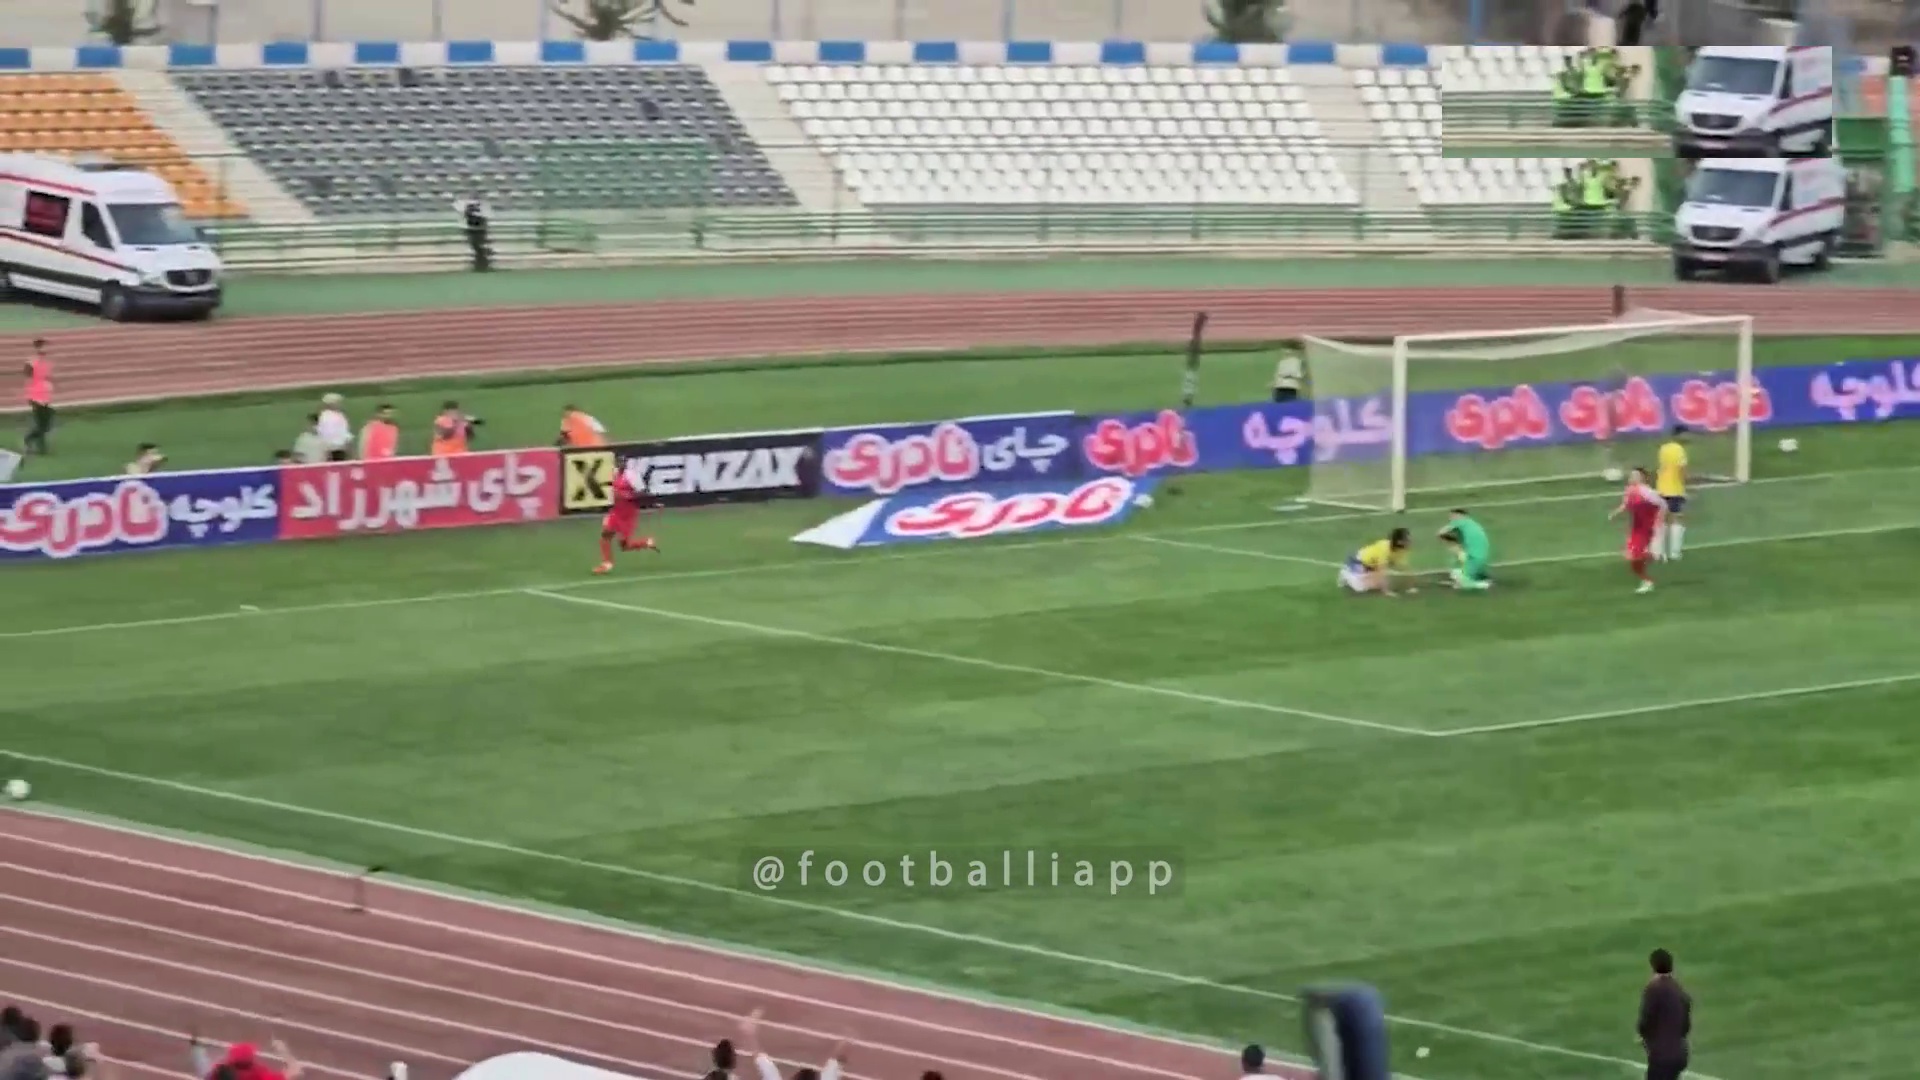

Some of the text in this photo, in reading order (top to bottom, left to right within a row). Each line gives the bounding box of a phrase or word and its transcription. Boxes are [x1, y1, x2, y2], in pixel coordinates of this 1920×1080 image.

[1447, 384, 1550, 449] نادری
[1561, 376, 1664, 439] نادری
[1811, 360, 1920, 420] لوچه
[624, 446, 806, 495] KENZAX
[823, 422, 1069, 493] چای نادری
[1084, 409, 1198, 476] نادری
[0, 480, 277, 558] کلوچه نادری
[291, 454, 546, 530] چای شهرزاد
[885, 476, 1132, 537] نادری
